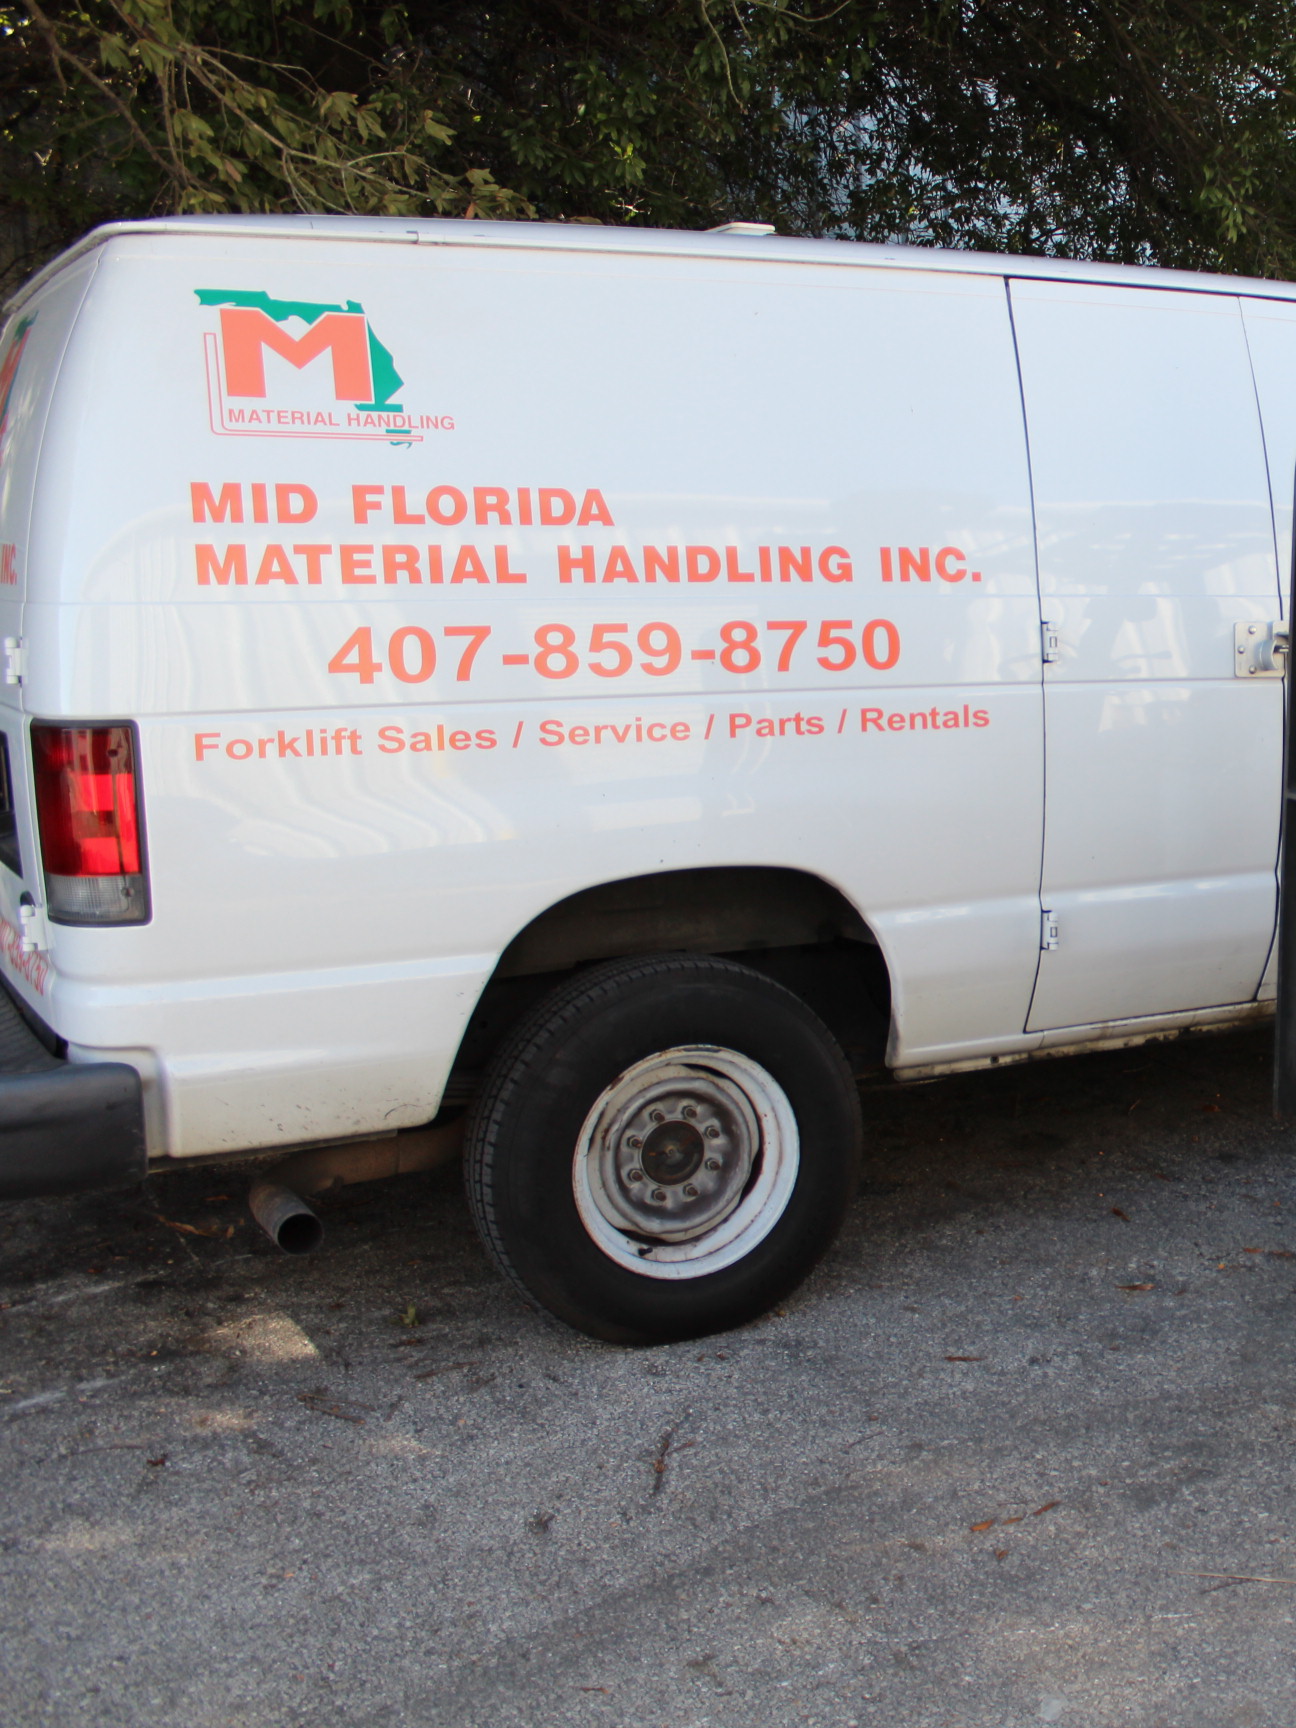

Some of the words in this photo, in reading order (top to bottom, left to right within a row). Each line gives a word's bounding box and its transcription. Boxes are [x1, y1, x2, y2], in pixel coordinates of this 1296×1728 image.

[218, 307, 373, 403] M
[228, 408, 340, 426] MATERIAL
[347, 413, 456, 430] HANDLING
[189, 481, 319, 525] MID
[351, 484, 616, 527] FLORIDA
[194, 543, 528, 586] MATERIAL
[556, 543, 856, 585] HANDLING
[879, 546, 983, 585] INC.
[327, 618, 902, 686] 407-859-8750
[193, 727, 364, 762] Forklift
[377, 723, 498, 754] Sales
[538, 716, 692, 748] Service
[728, 711, 826, 739] Parts
[859, 704, 991, 733] Rentals
